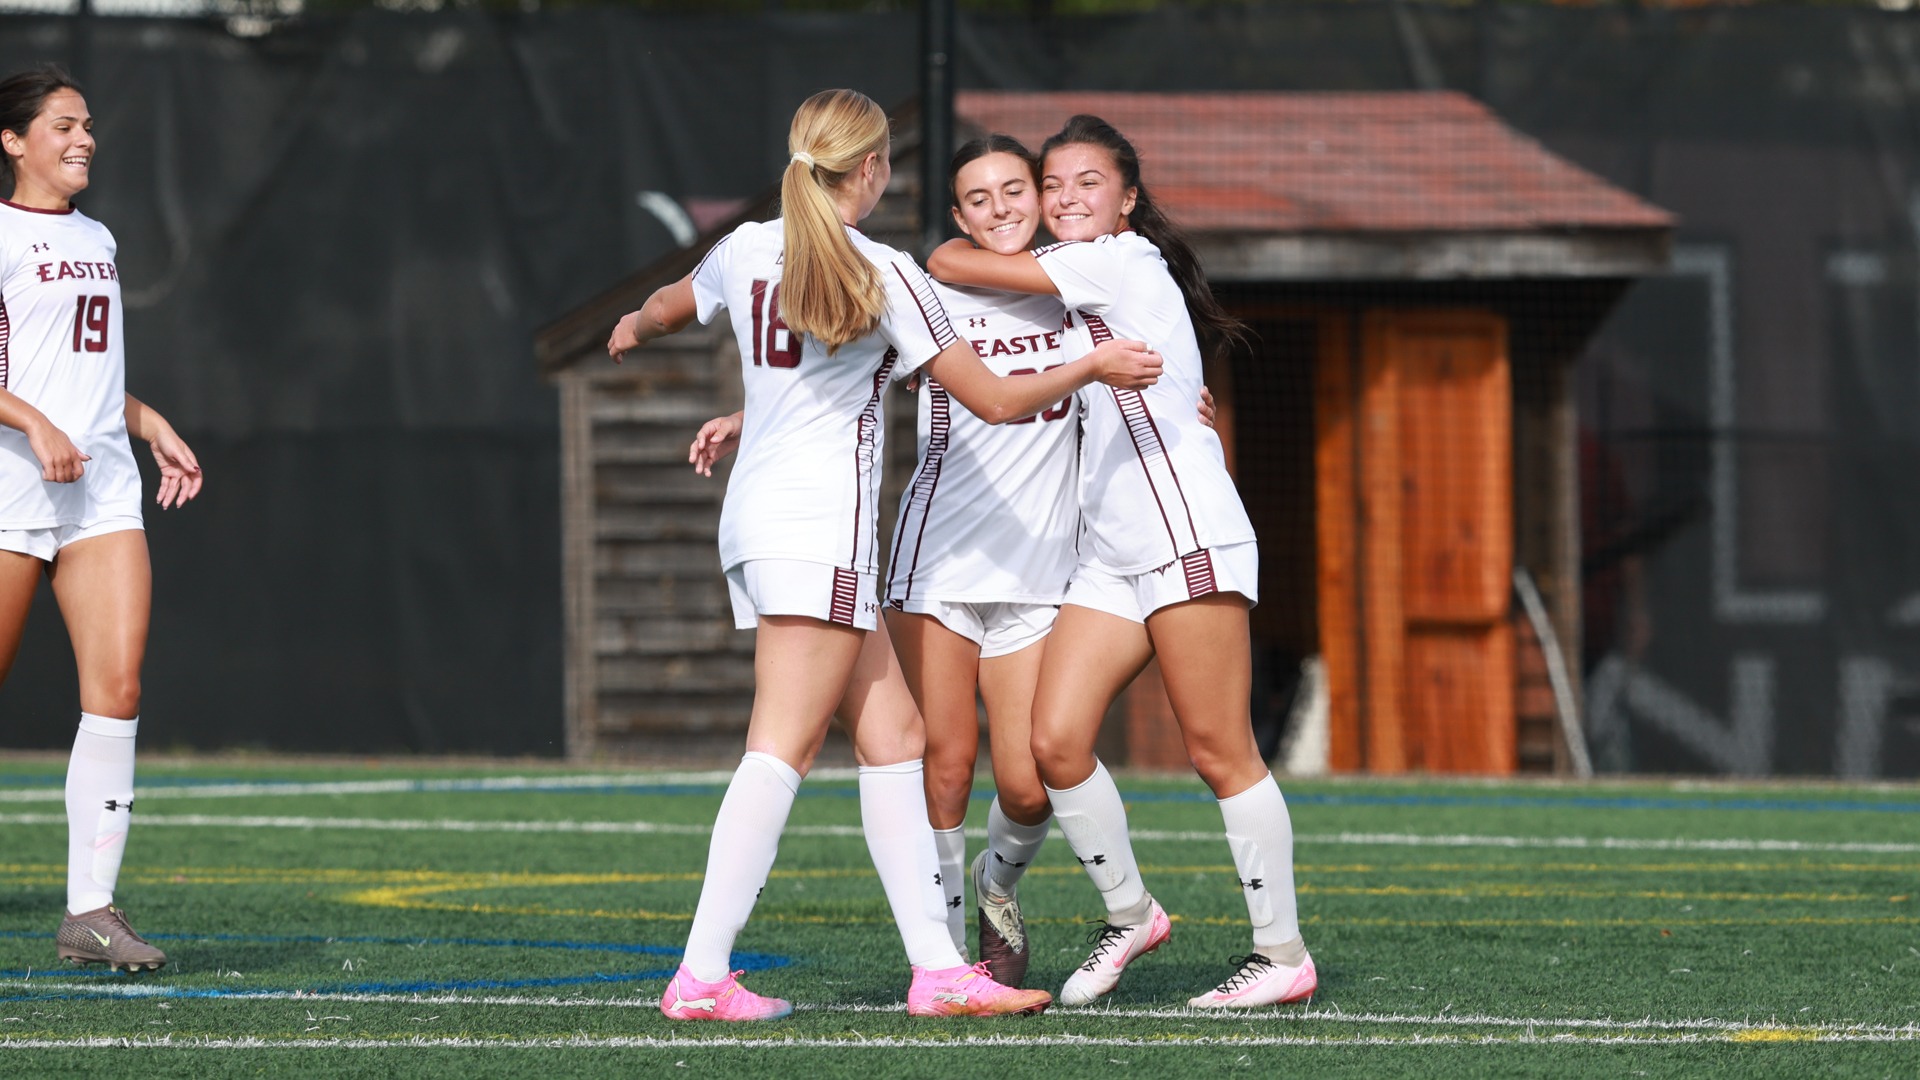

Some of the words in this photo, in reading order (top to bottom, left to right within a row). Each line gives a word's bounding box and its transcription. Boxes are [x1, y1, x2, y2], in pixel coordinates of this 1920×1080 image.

[72, 294, 110, 353] 19
[751, 278, 802, 369] 18
[969, 310, 1075, 358] EASTEN
